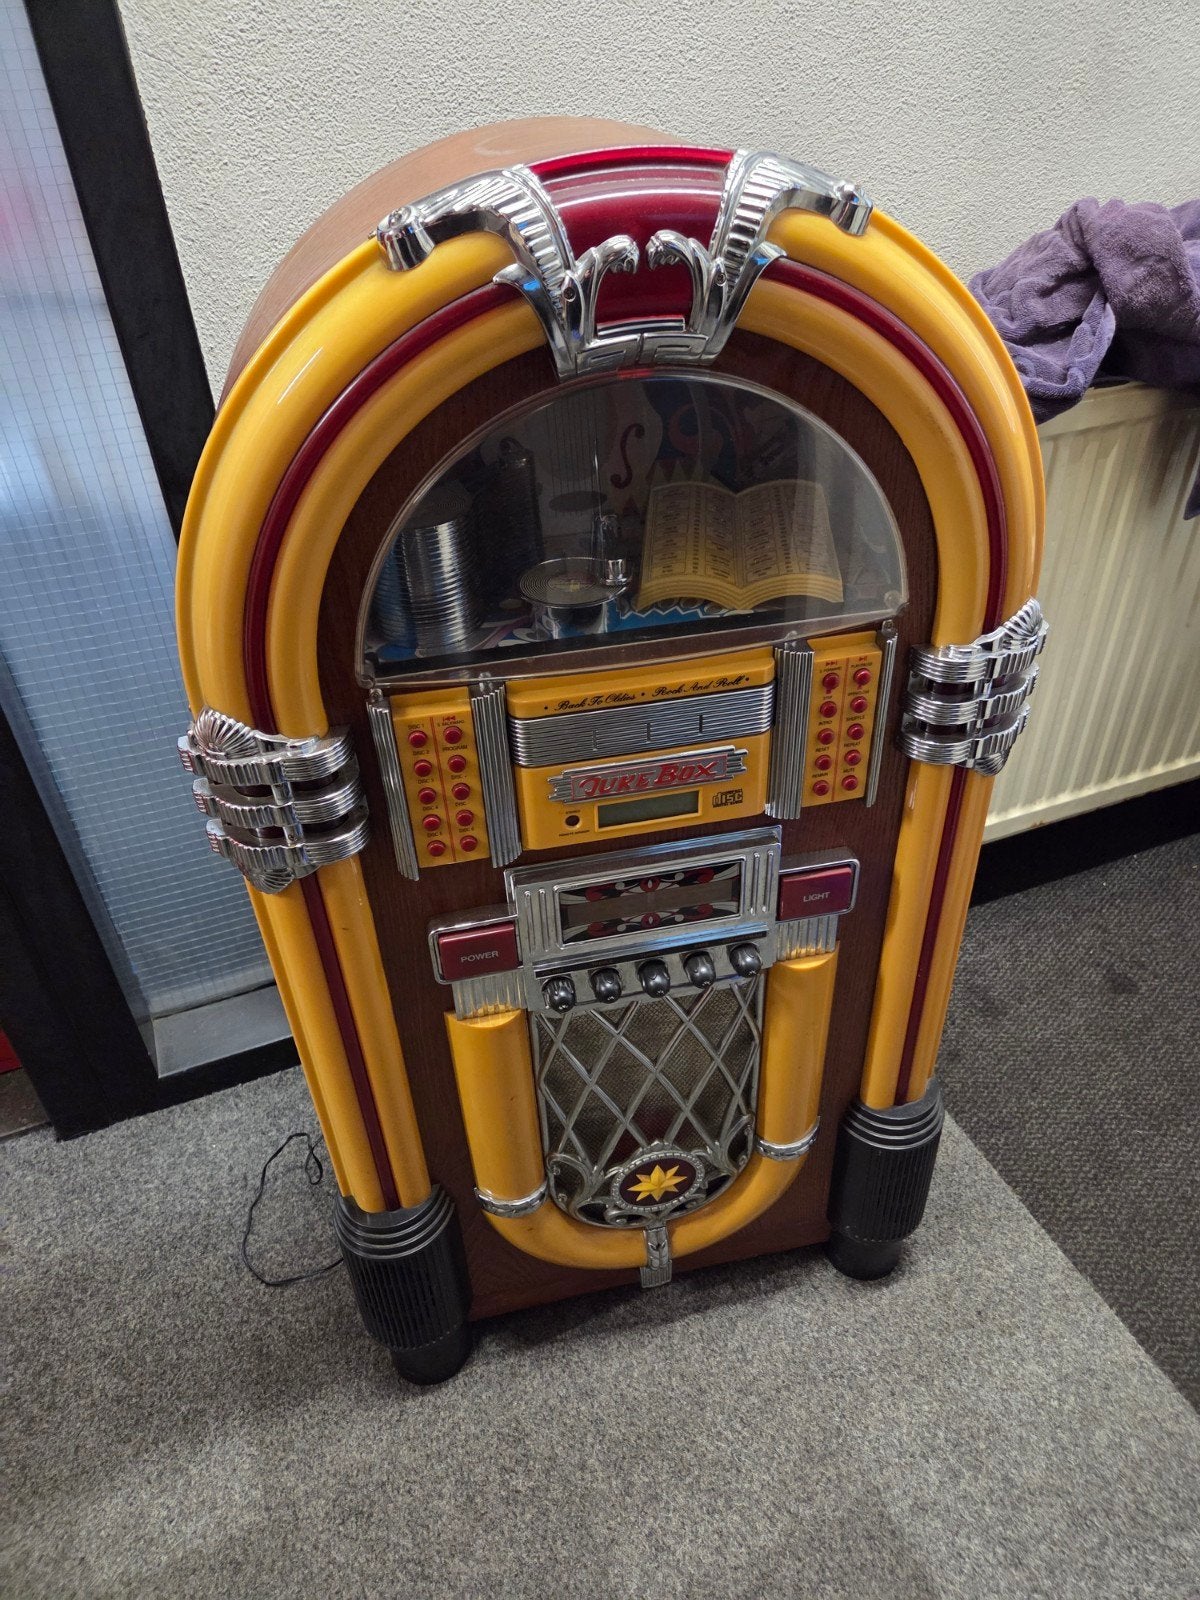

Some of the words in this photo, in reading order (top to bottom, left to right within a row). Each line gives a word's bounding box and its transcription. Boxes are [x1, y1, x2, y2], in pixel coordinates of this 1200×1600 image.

[651, 686, 683, 697] Rock
[683, 681, 713, 693] And
[713, 674, 746, 688] Roll
[554, 697, 586, 712] Back
[587, 696, 603, 706] To
[605, 692, 636, 704] Oldies
[578, 770, 656, 796] JUKE
[653, 760, 719, 785] BOX
[803, 892, 830, 902] LIGHT
[460, 950, 498, 963] POWER
